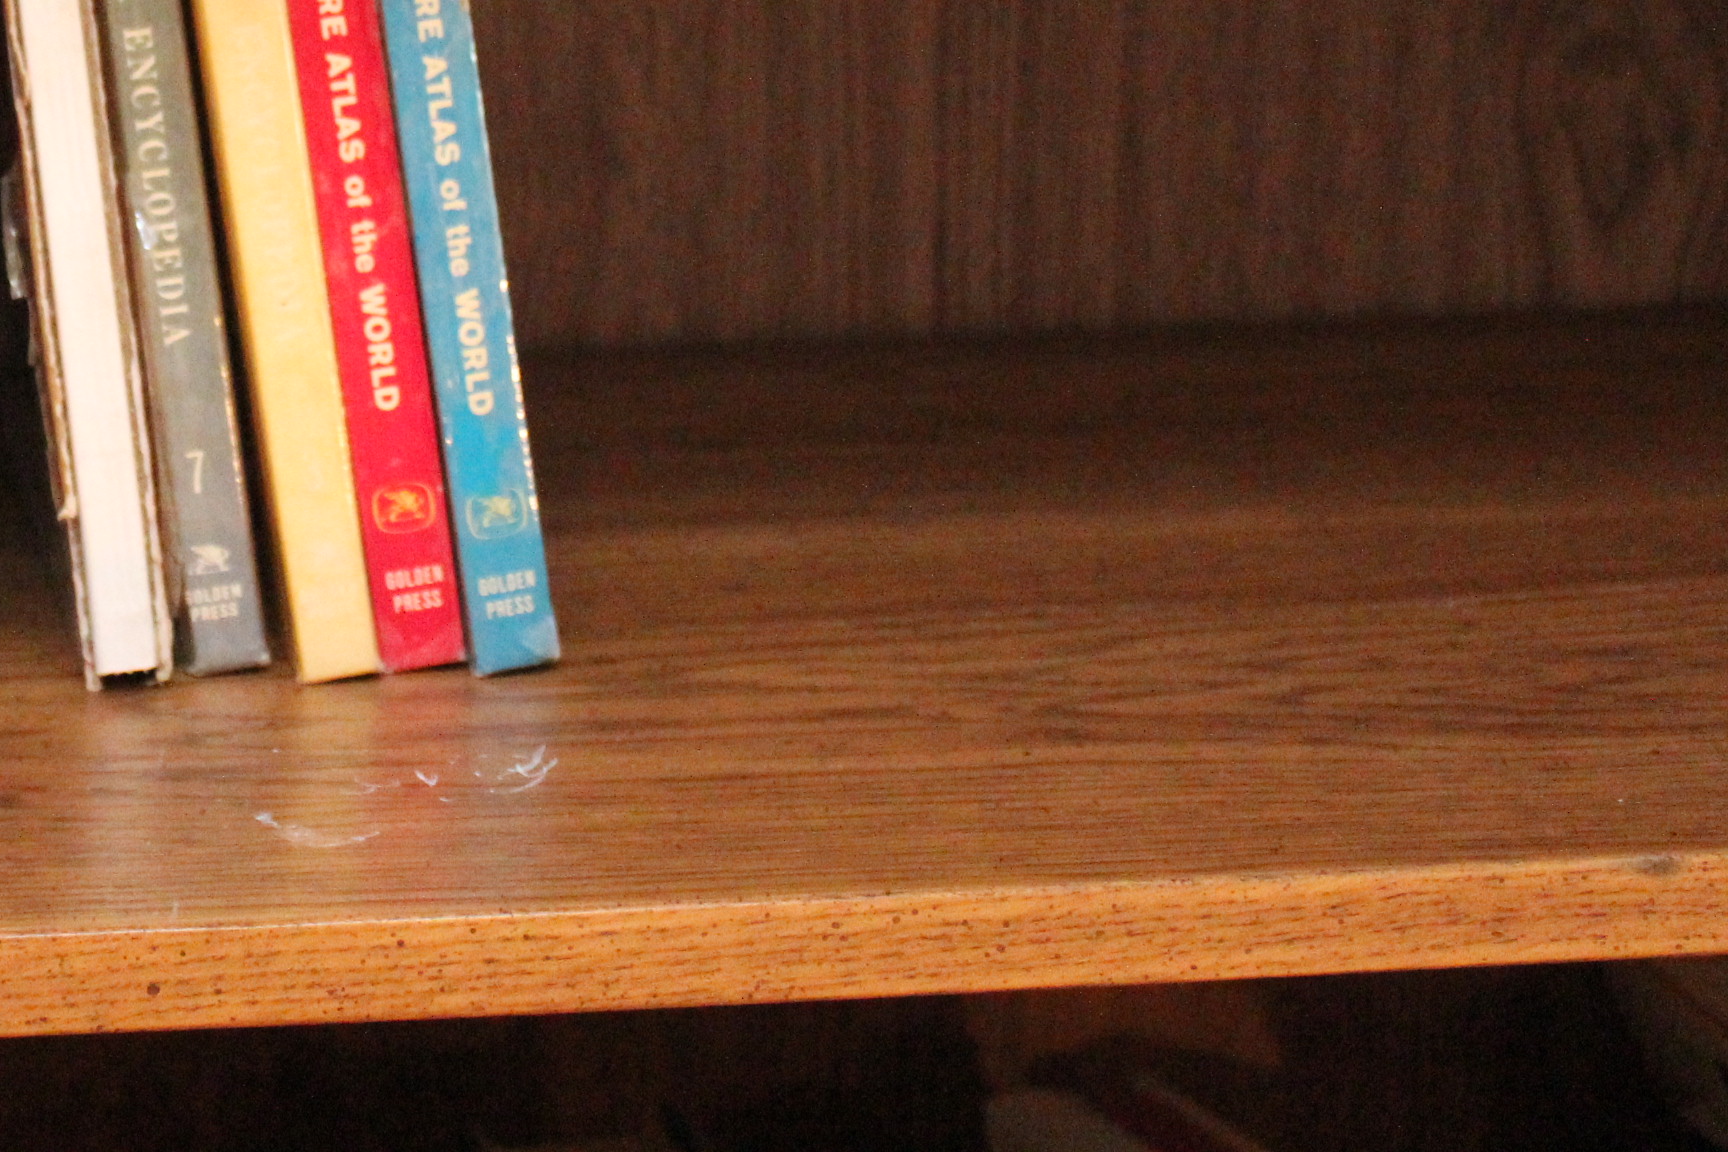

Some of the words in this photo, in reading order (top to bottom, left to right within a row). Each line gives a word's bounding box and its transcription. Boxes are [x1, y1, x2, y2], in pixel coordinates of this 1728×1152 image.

[325, 52, 366, 164] ATLAS
[422, 54, 461, 167] ATLAS
[122, 26, 193, 347] ENCYCLOPEDIA
[344, 174, 373, 208] of
[439, 178, 468, 213] of
[351, 220, 379, 274] the
[446, 223, 473, 277] the
[359, 282, 400, 412] WORLD
[455, 288, 495, 417] WORLD
[184, 449, 206, 494] 7
[385, 564, 445, 591] GOLDEN
[478, 569, 536, 597] GOLDEN
[189, 601, 239, 622] PRESS
[393, 590, 445, 615] PRESS
[486, 594, 535, 619] PRESS
